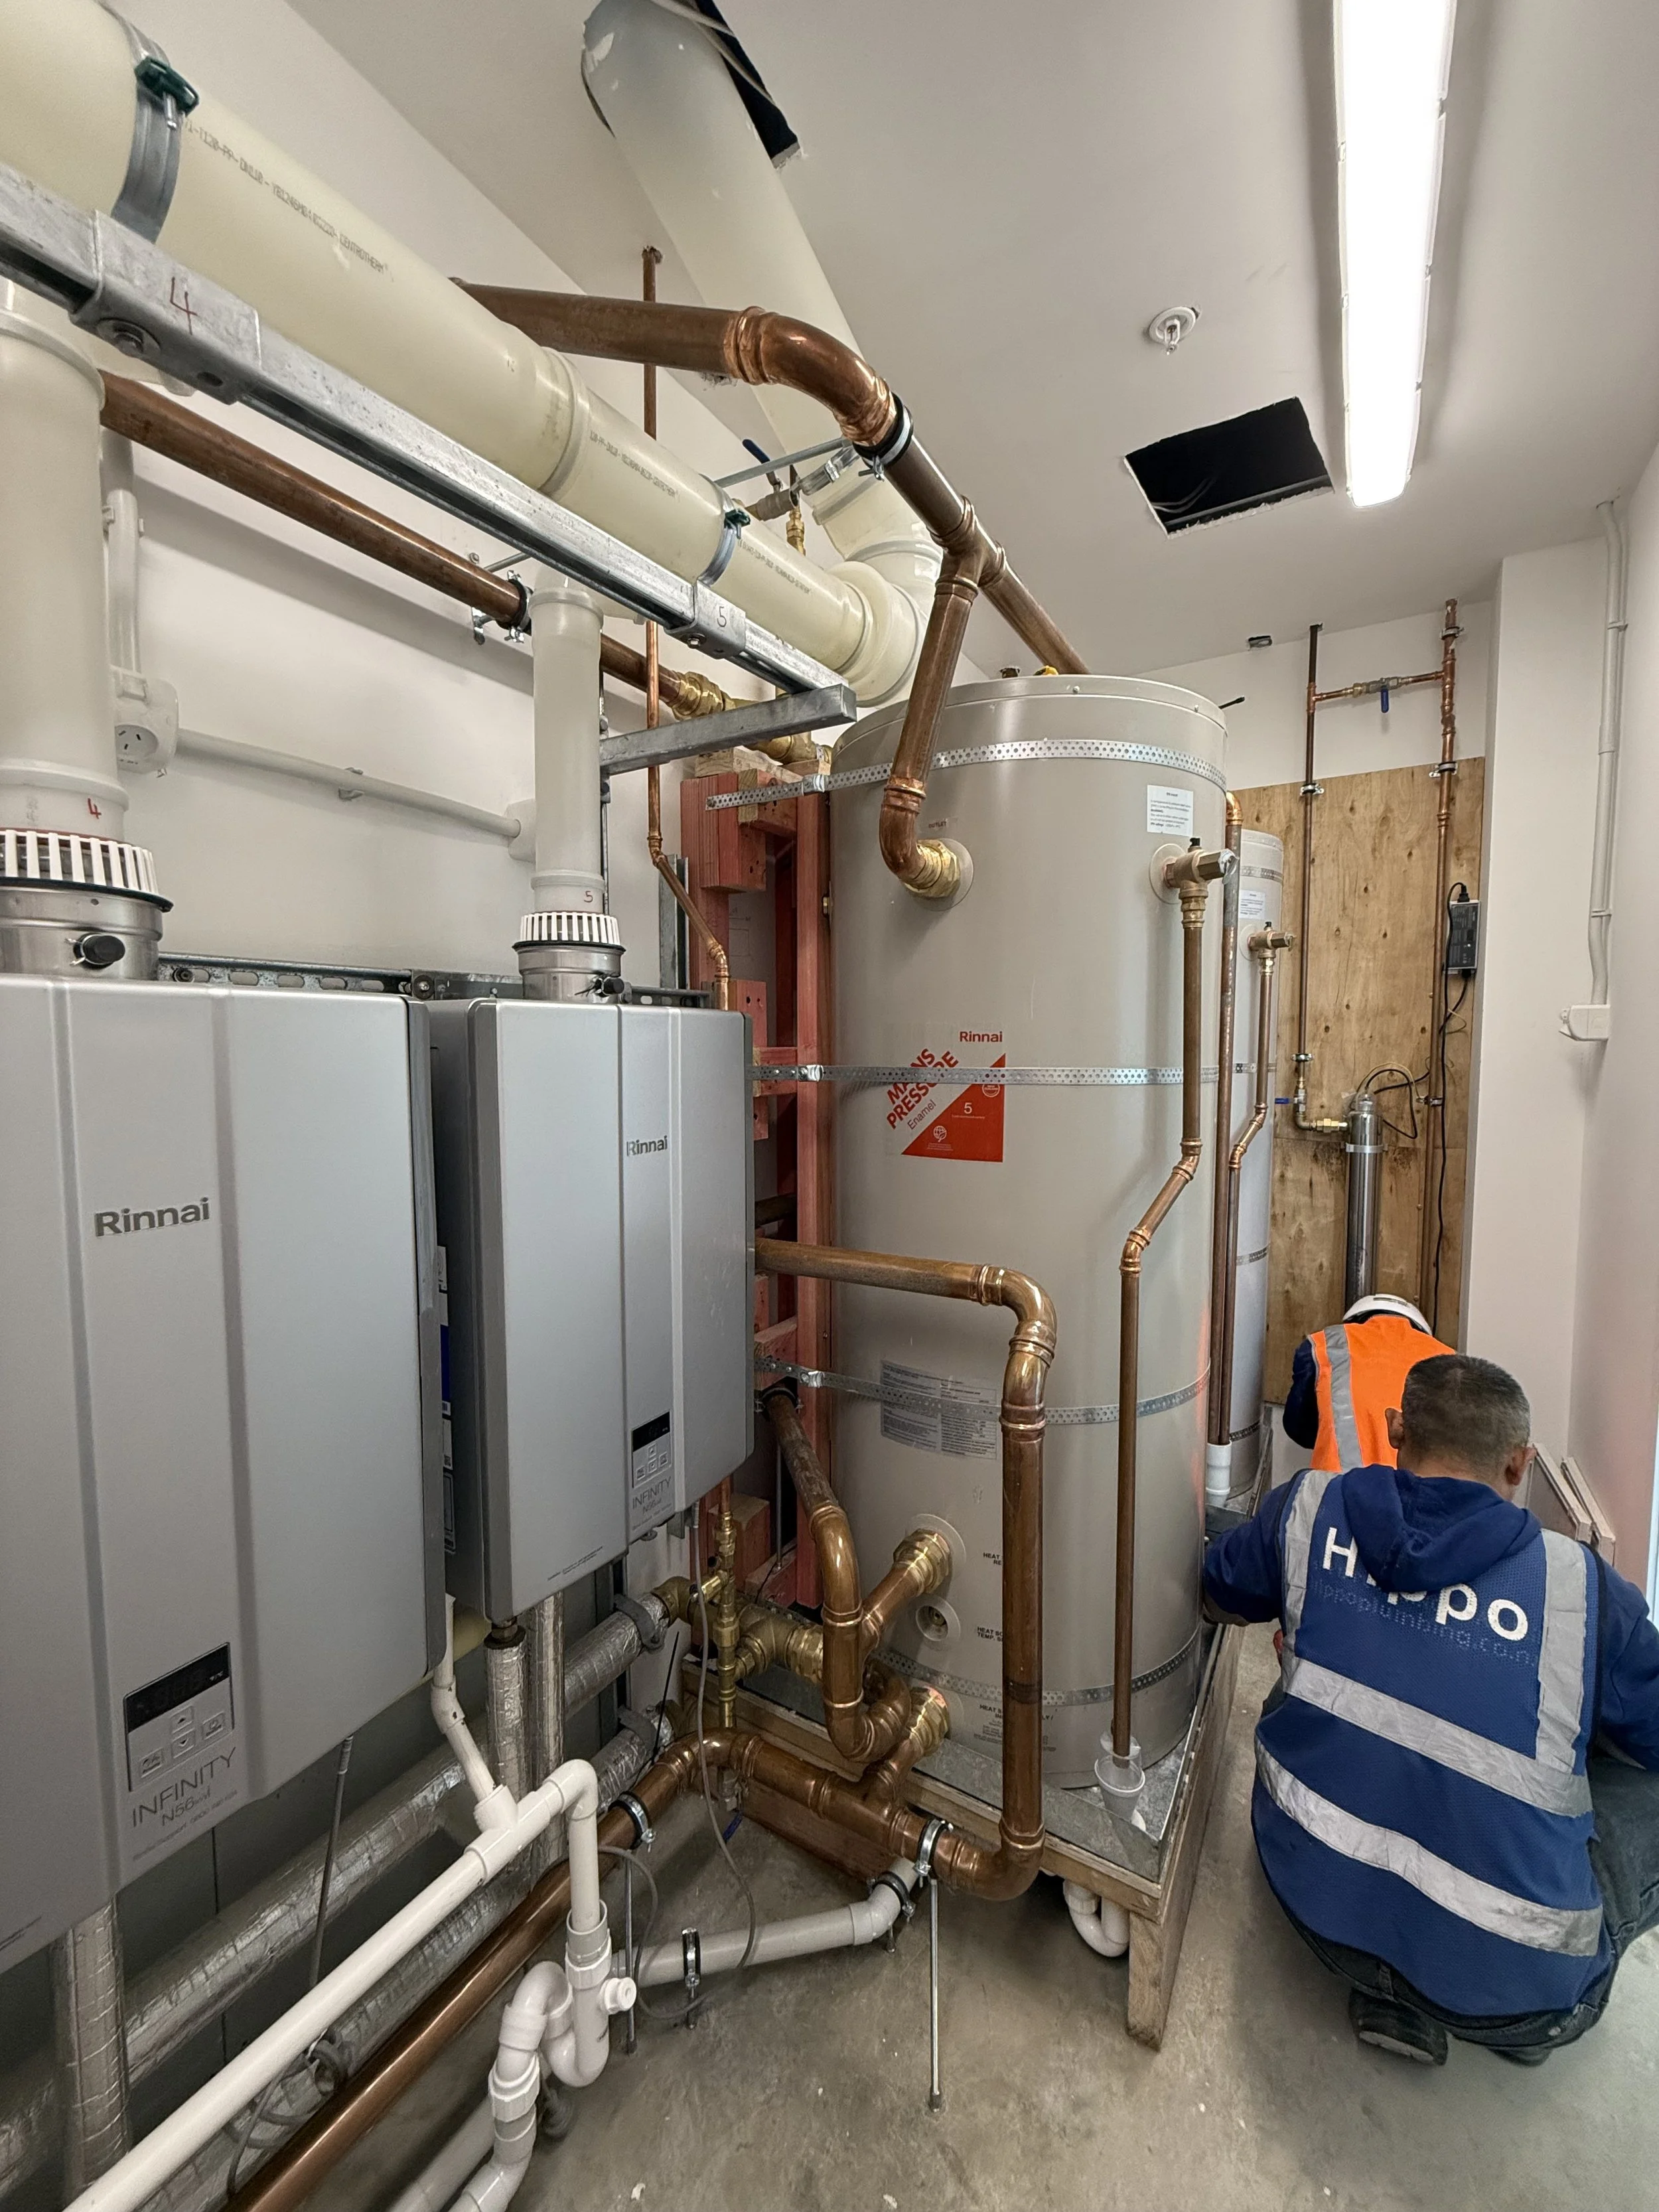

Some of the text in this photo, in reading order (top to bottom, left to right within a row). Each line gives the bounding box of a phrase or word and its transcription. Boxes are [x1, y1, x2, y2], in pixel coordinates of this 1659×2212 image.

[170, 277, 197, 334] 4
[717, 605, 727, 627] 5
[87, 798, 102, 819] 4
[584, 890, 593, 903] 5
[959, 1031, 1003, 1043] Rinnai
[887, 1048, 935, 1105] MNS
[906, 1098, 936, 1130] Enamel
[964, 1102, 972, 1114] 5
[626, 1135, 668, 1157] Rinnai
[94, 1197, 210, 1237] Rinnai
[631, 1475, 672, 1510] INFINITY
[977, 1626, 994, 1636] HEAT
[977, 1631, 995, 1641] TEMP.
[979, 1704, 996, 1713] HEAT
[132, 1746, 236, 1828] INFINITY
